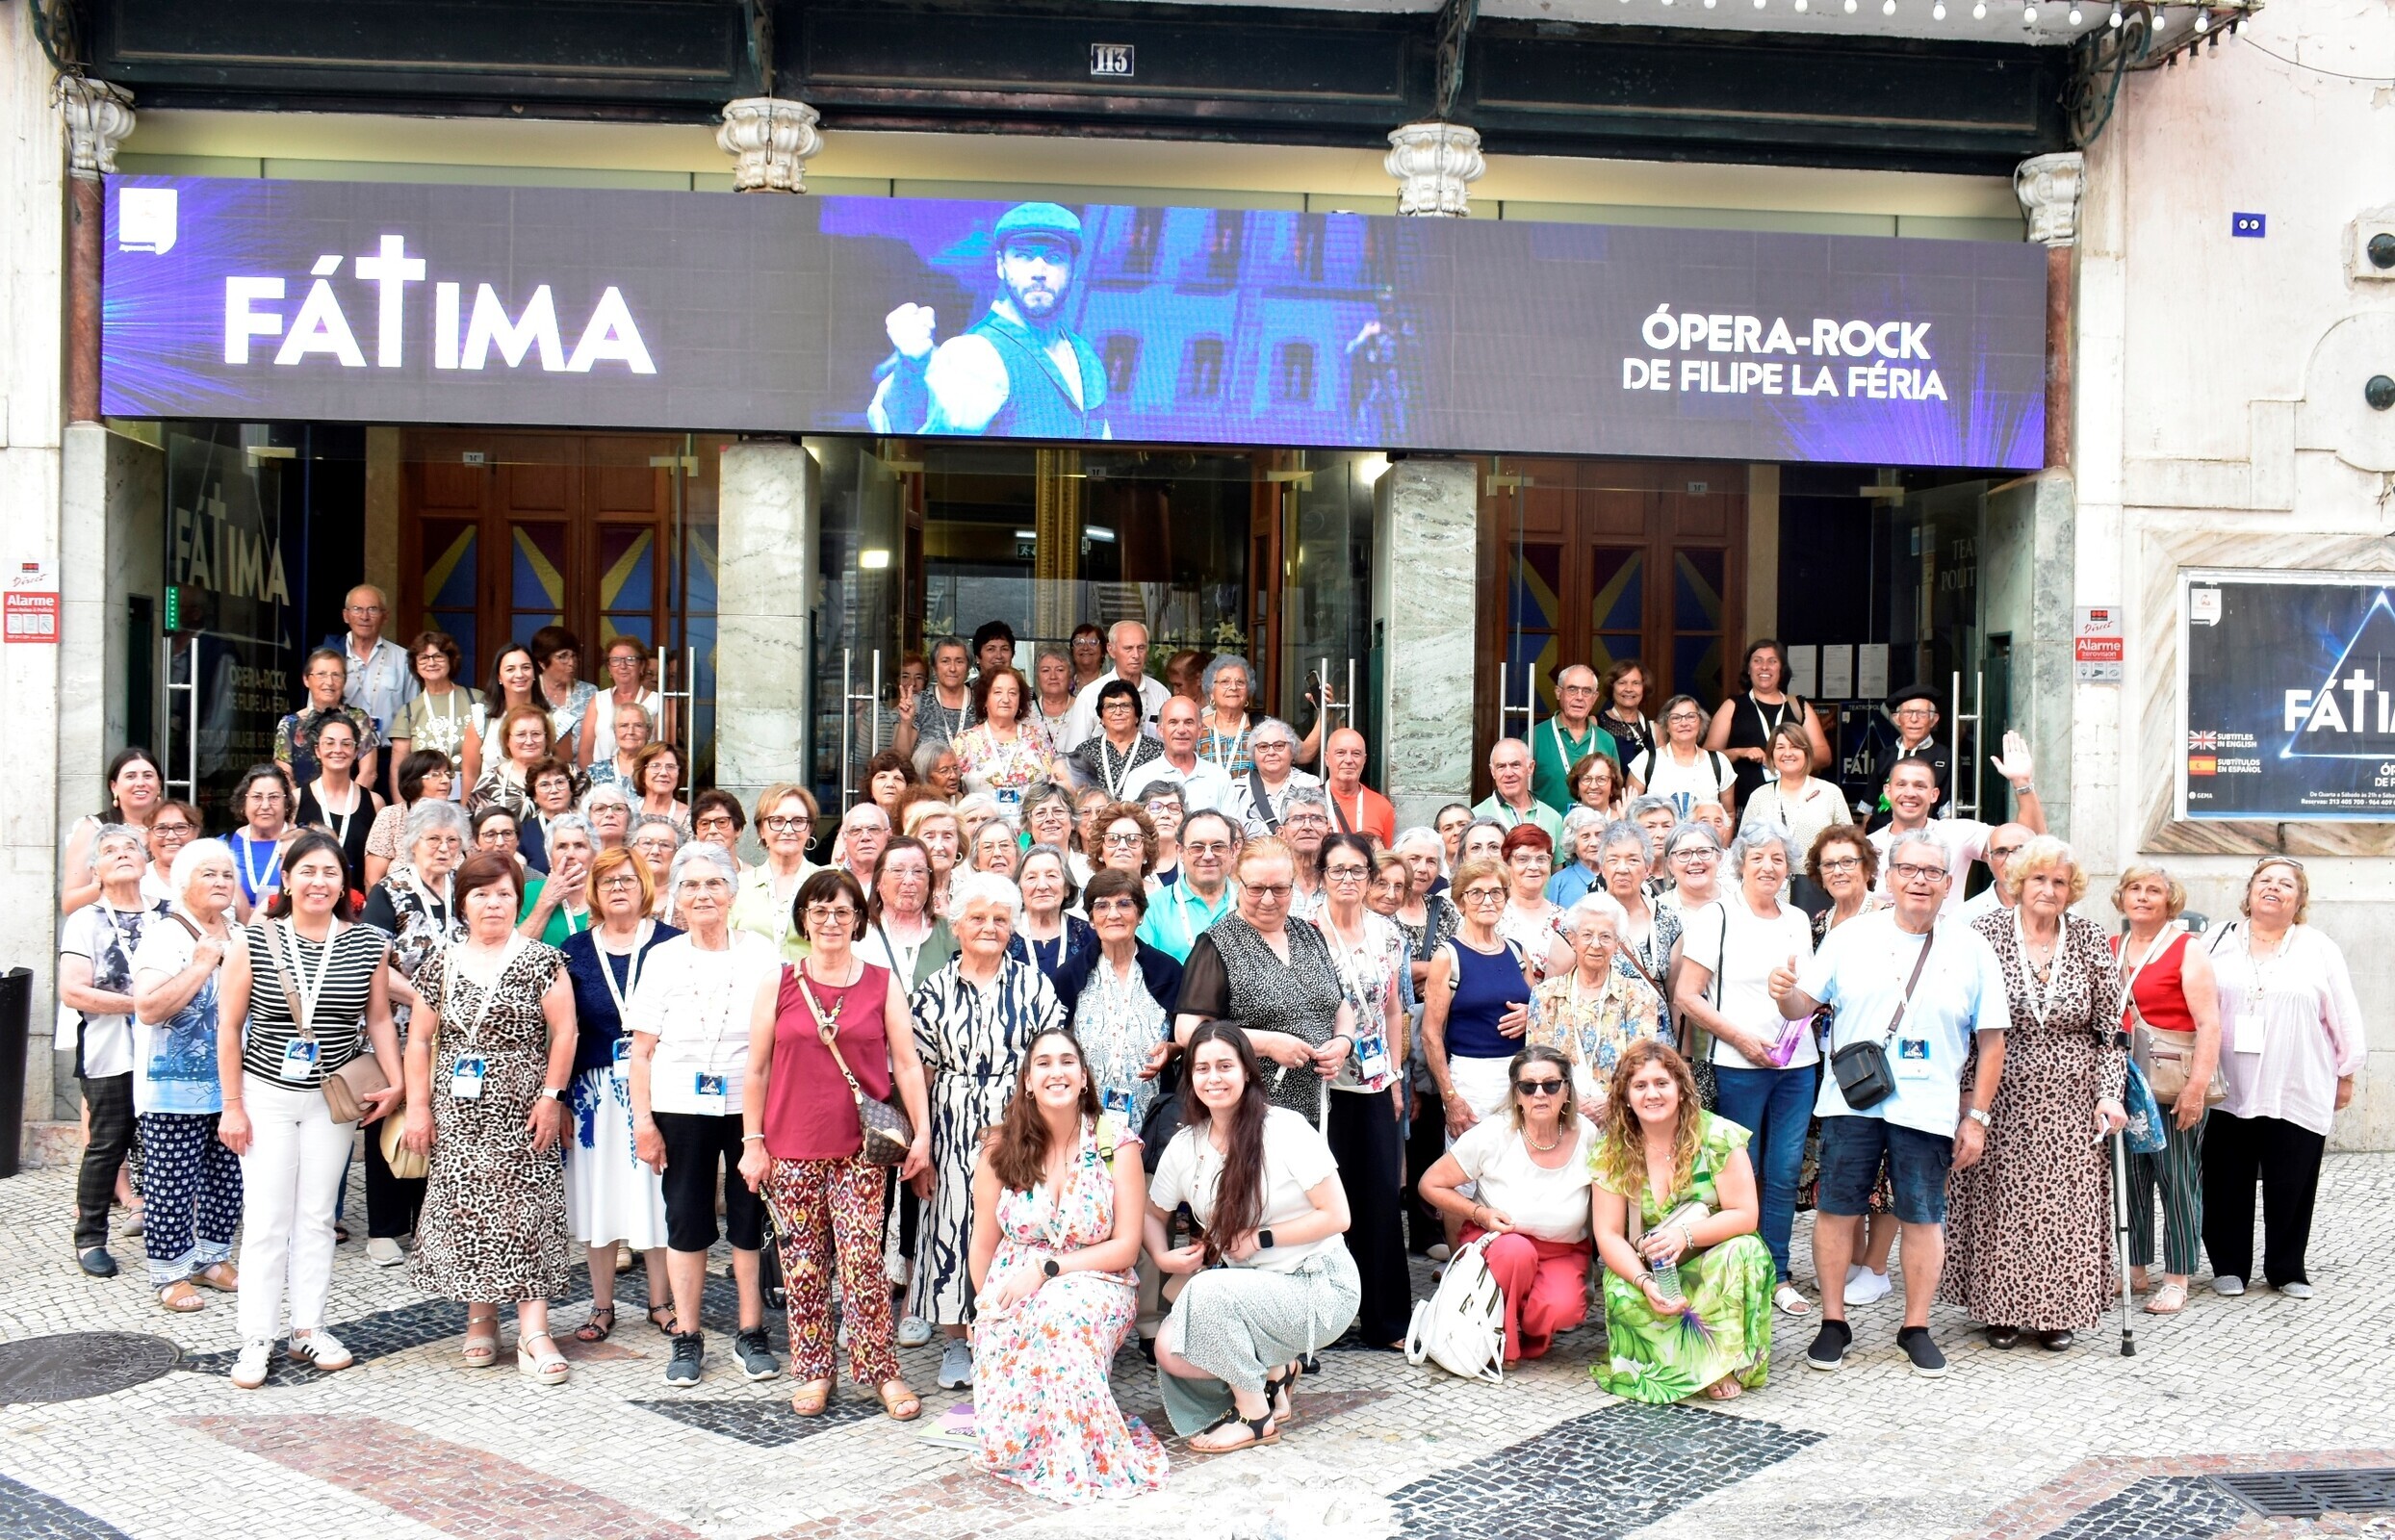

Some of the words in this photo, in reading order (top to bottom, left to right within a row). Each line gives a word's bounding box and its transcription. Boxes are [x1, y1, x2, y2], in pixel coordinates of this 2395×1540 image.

[1096, 46, 1128, 73] 113
[224, 234, 657, 374] FÁTIMA
[1641, 302, 1932, 360] ÓPERA-ROCK
[1623, 357, 1671, 391] DE
[1681, 360, 1784, 395] FILIPE
[1791, 364, 1840, 397] LA
[1847, 359, 1948, 401] FÉRIA
[175, 482, 290, 606] FÁTIMA
[7, 594, 55, 606] Alarme
[2077, 639, 2122, 652] Alarme
[2217, 757, 2260, 766] SUBTÍTULOS
[2375, 778, 2389, 787] DE
